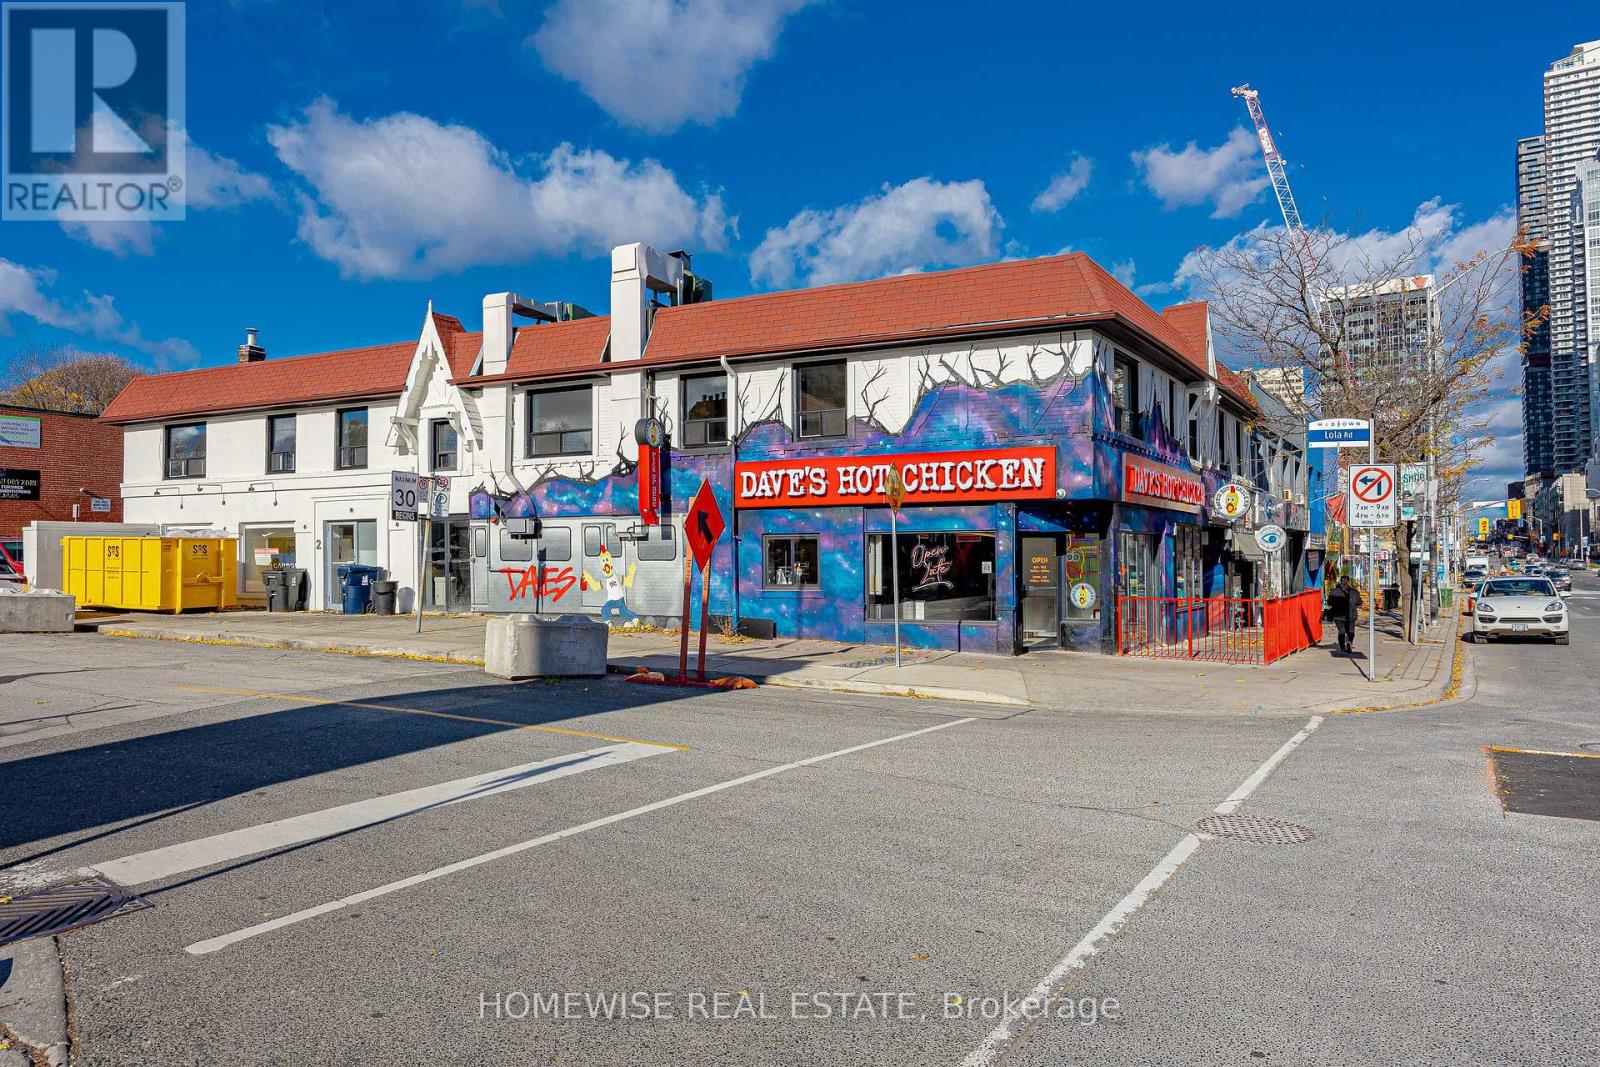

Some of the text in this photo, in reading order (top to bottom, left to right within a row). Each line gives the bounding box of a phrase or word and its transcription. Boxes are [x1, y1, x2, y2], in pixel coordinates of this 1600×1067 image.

[1324, 430, 1342, 439] Lola
[740, 457, 1046, 498] DAVE'S HOT CHICKEN
[394, 488, 416, 508] 30
[315, 539, 322, 550] 2
[911, 544, 948, 569] Open
[1031, 556, 1049, 564] OPEN
[921, 556, 953, 585] Late
